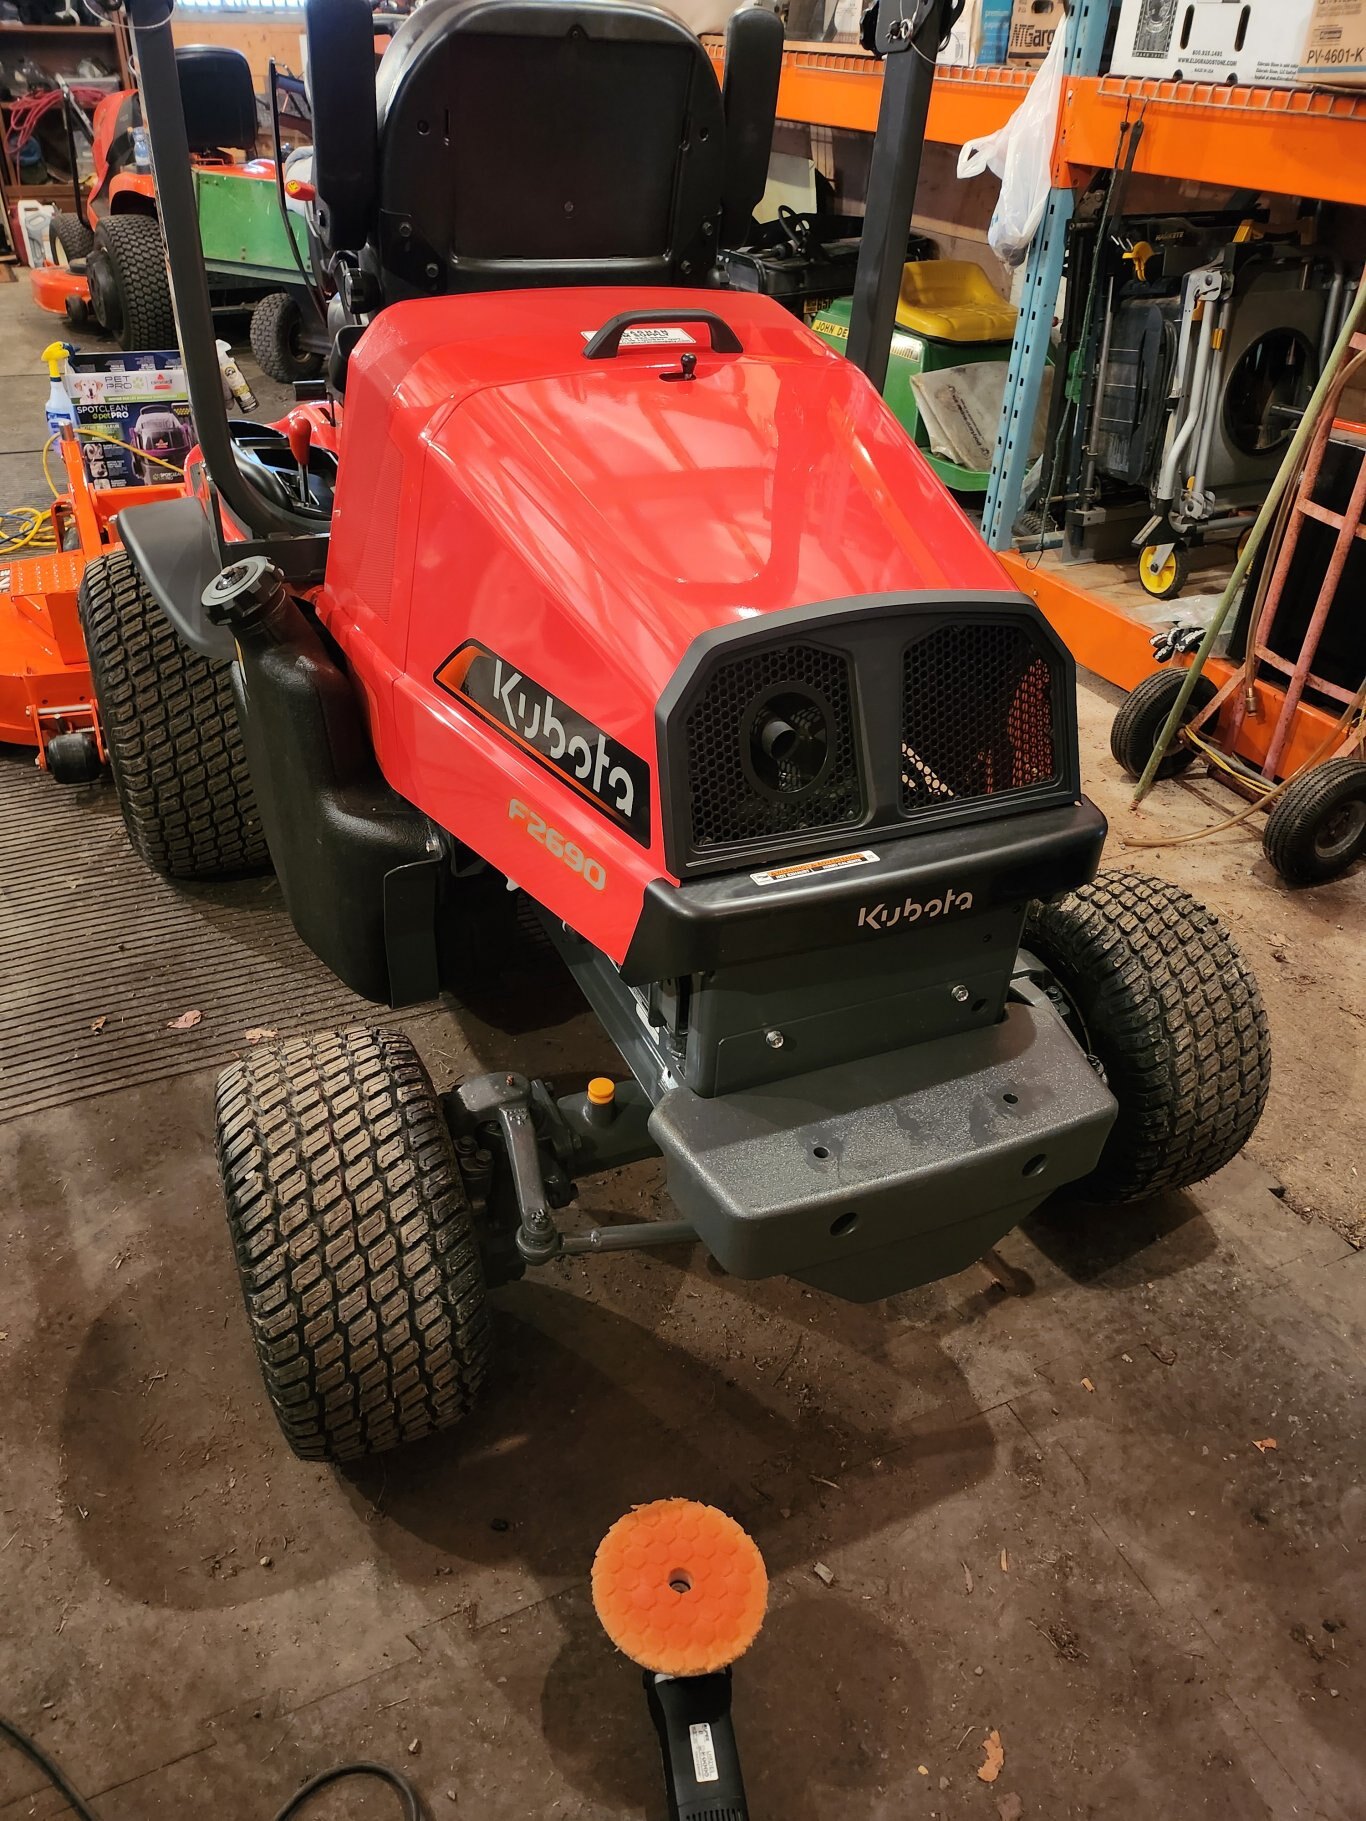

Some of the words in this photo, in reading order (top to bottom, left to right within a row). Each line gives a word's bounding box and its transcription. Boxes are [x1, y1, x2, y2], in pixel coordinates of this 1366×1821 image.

[1307, 47, 1364, 65] PV-4601-K
[816, 321, 835, 334] JOHN
[837, 327, 848, 338] DE
[77, 404, 128, 414] SPOTCLEAN
[493, 659, 635, 818] Kubota
[508, 798, 606, 891] F2690
[857, 888, 973, 930] Kubota
